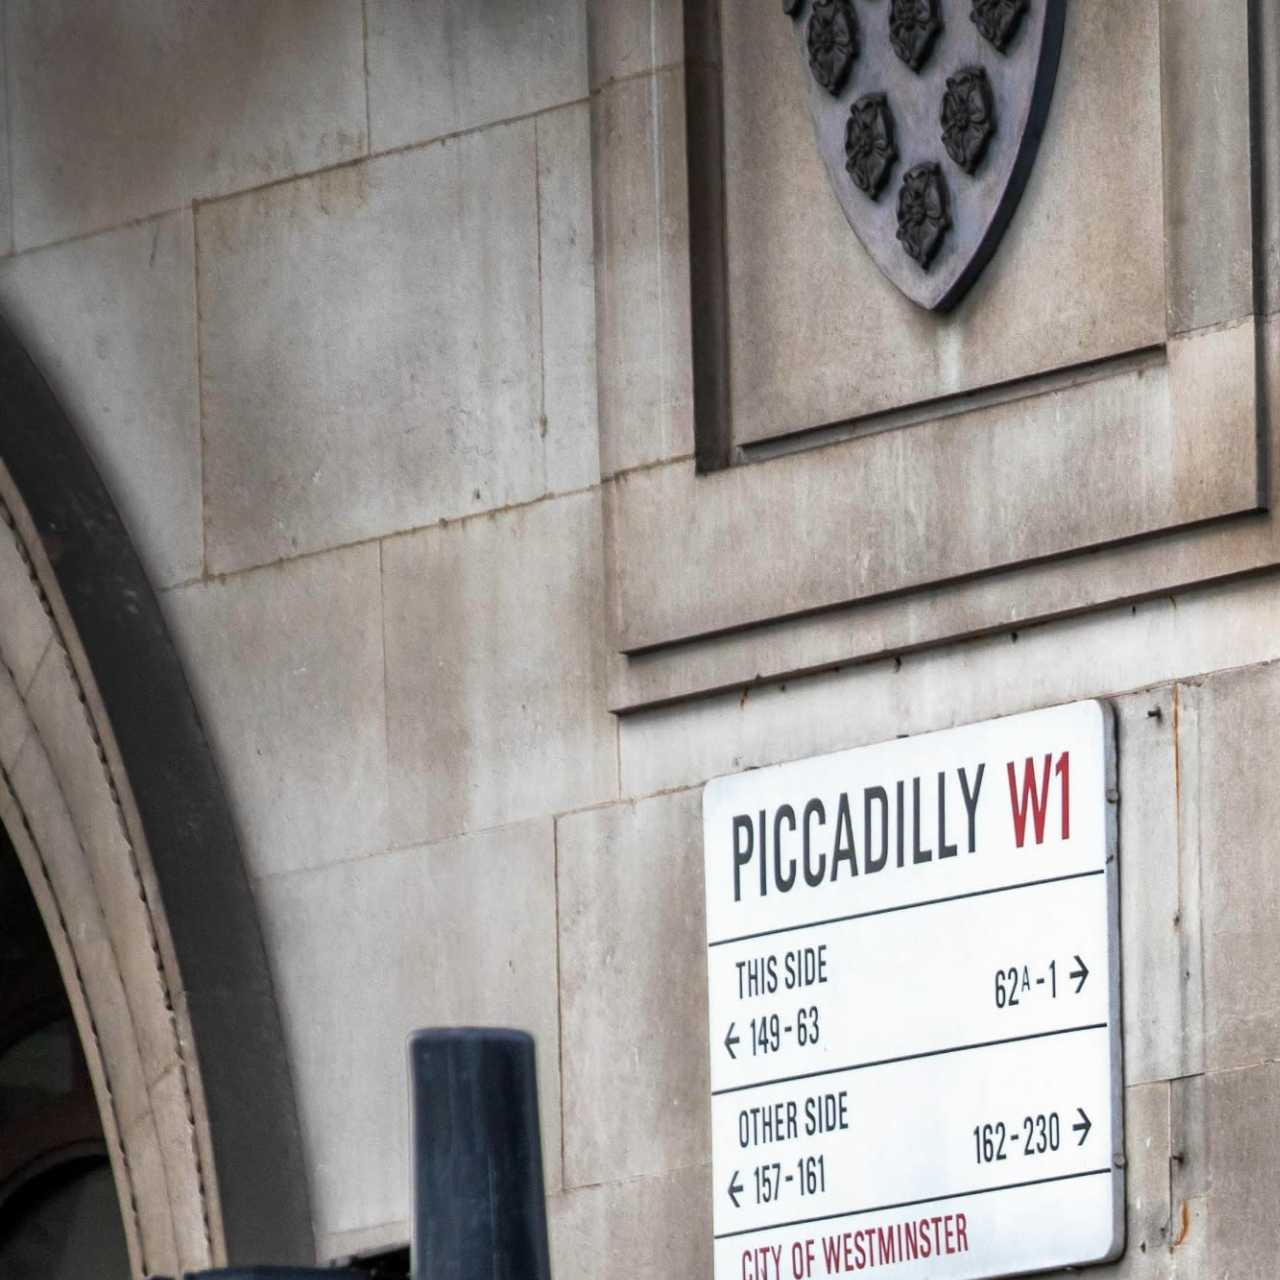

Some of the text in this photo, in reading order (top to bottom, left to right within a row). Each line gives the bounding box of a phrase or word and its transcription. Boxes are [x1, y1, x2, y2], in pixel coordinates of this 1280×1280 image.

[733, 752, 1069, 901] PICCADILLY W1
[736, 945, 828, 999] THIS SIDE
[739, 1092, 849, 1148] OTHER SIDE
[792, 1240, 815, 1280] OF
[822, 1214, 968, 1274] WESTMINSTER
